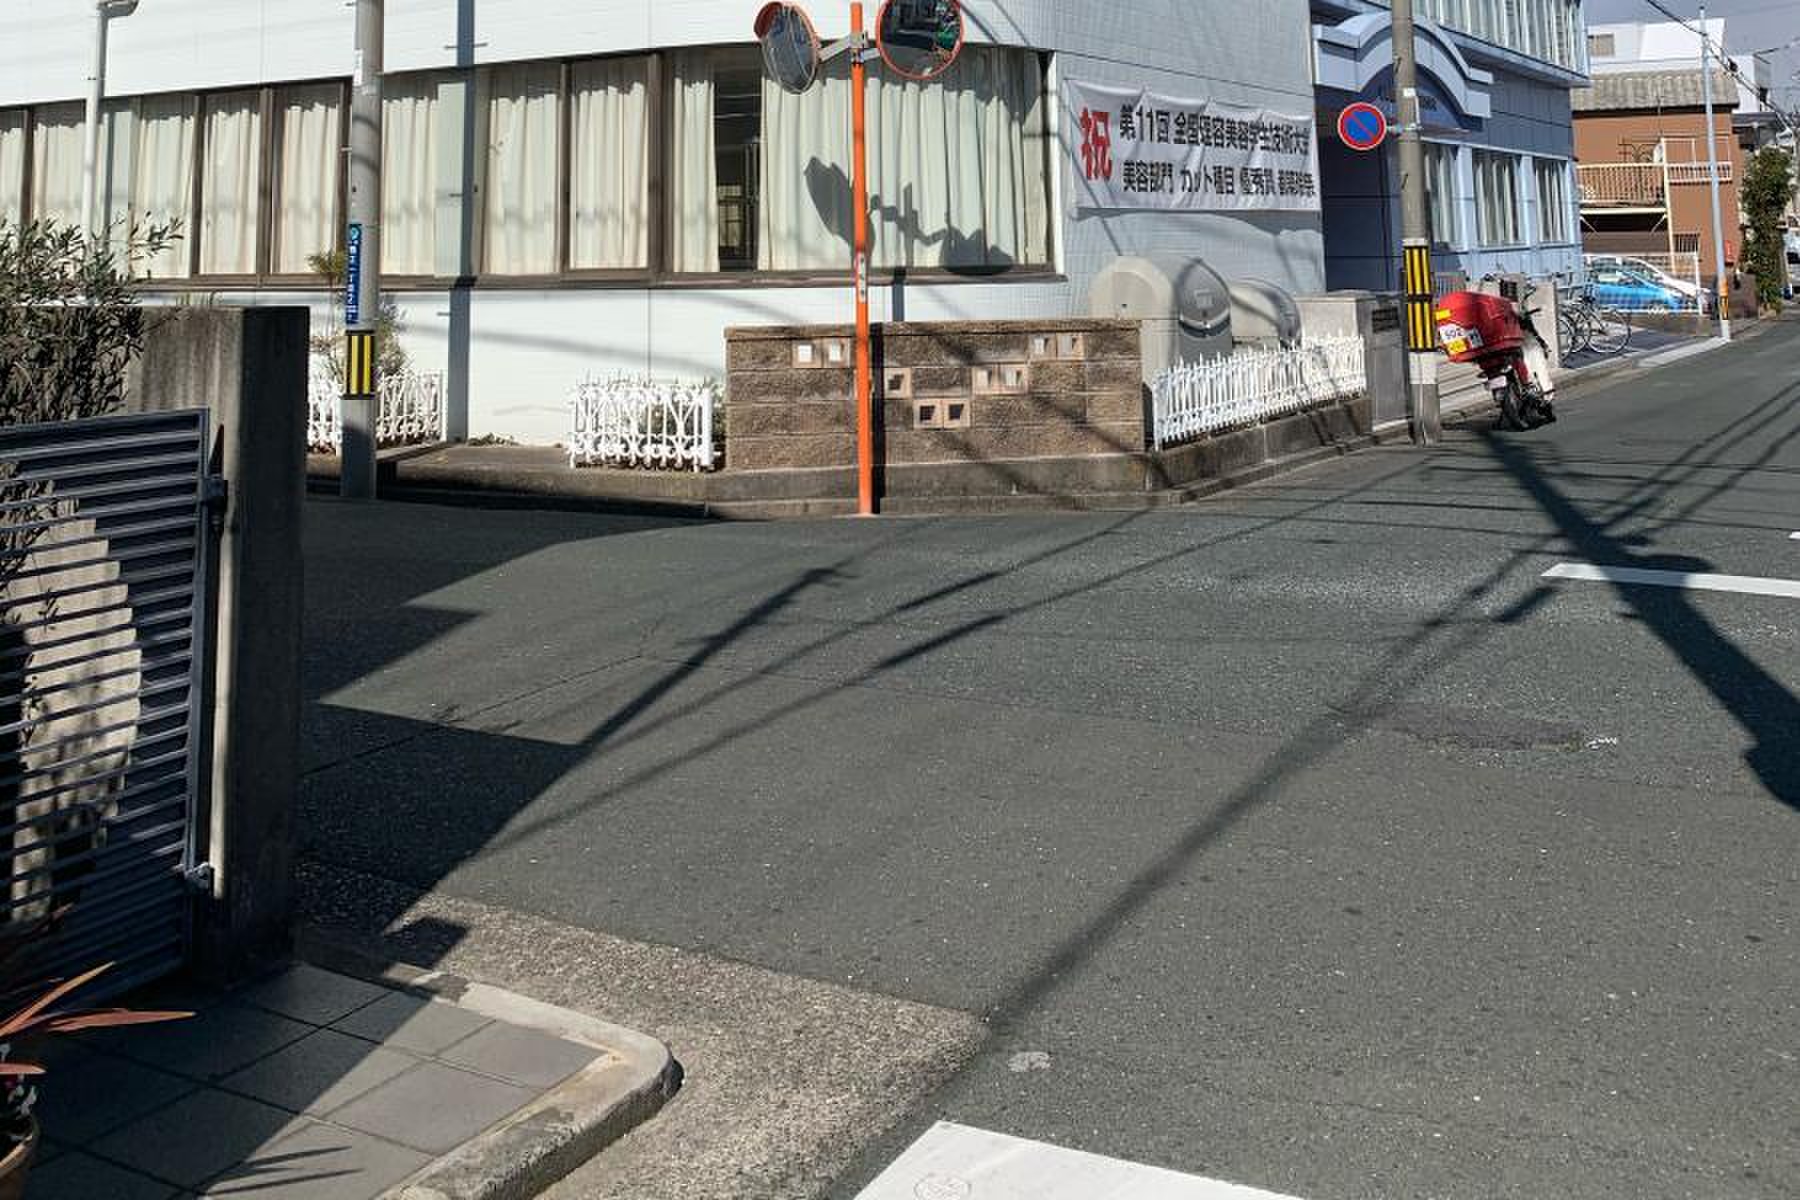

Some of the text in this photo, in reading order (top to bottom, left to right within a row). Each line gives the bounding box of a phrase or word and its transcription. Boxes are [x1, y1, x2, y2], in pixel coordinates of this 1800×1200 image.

[1119, 105, 1170, 143] 第11回
[1080, 107, 1113, 182] 祝
[1123, 162, 1173, 193] 美容部門
[1180, 165, 1236, 194] カット種目
